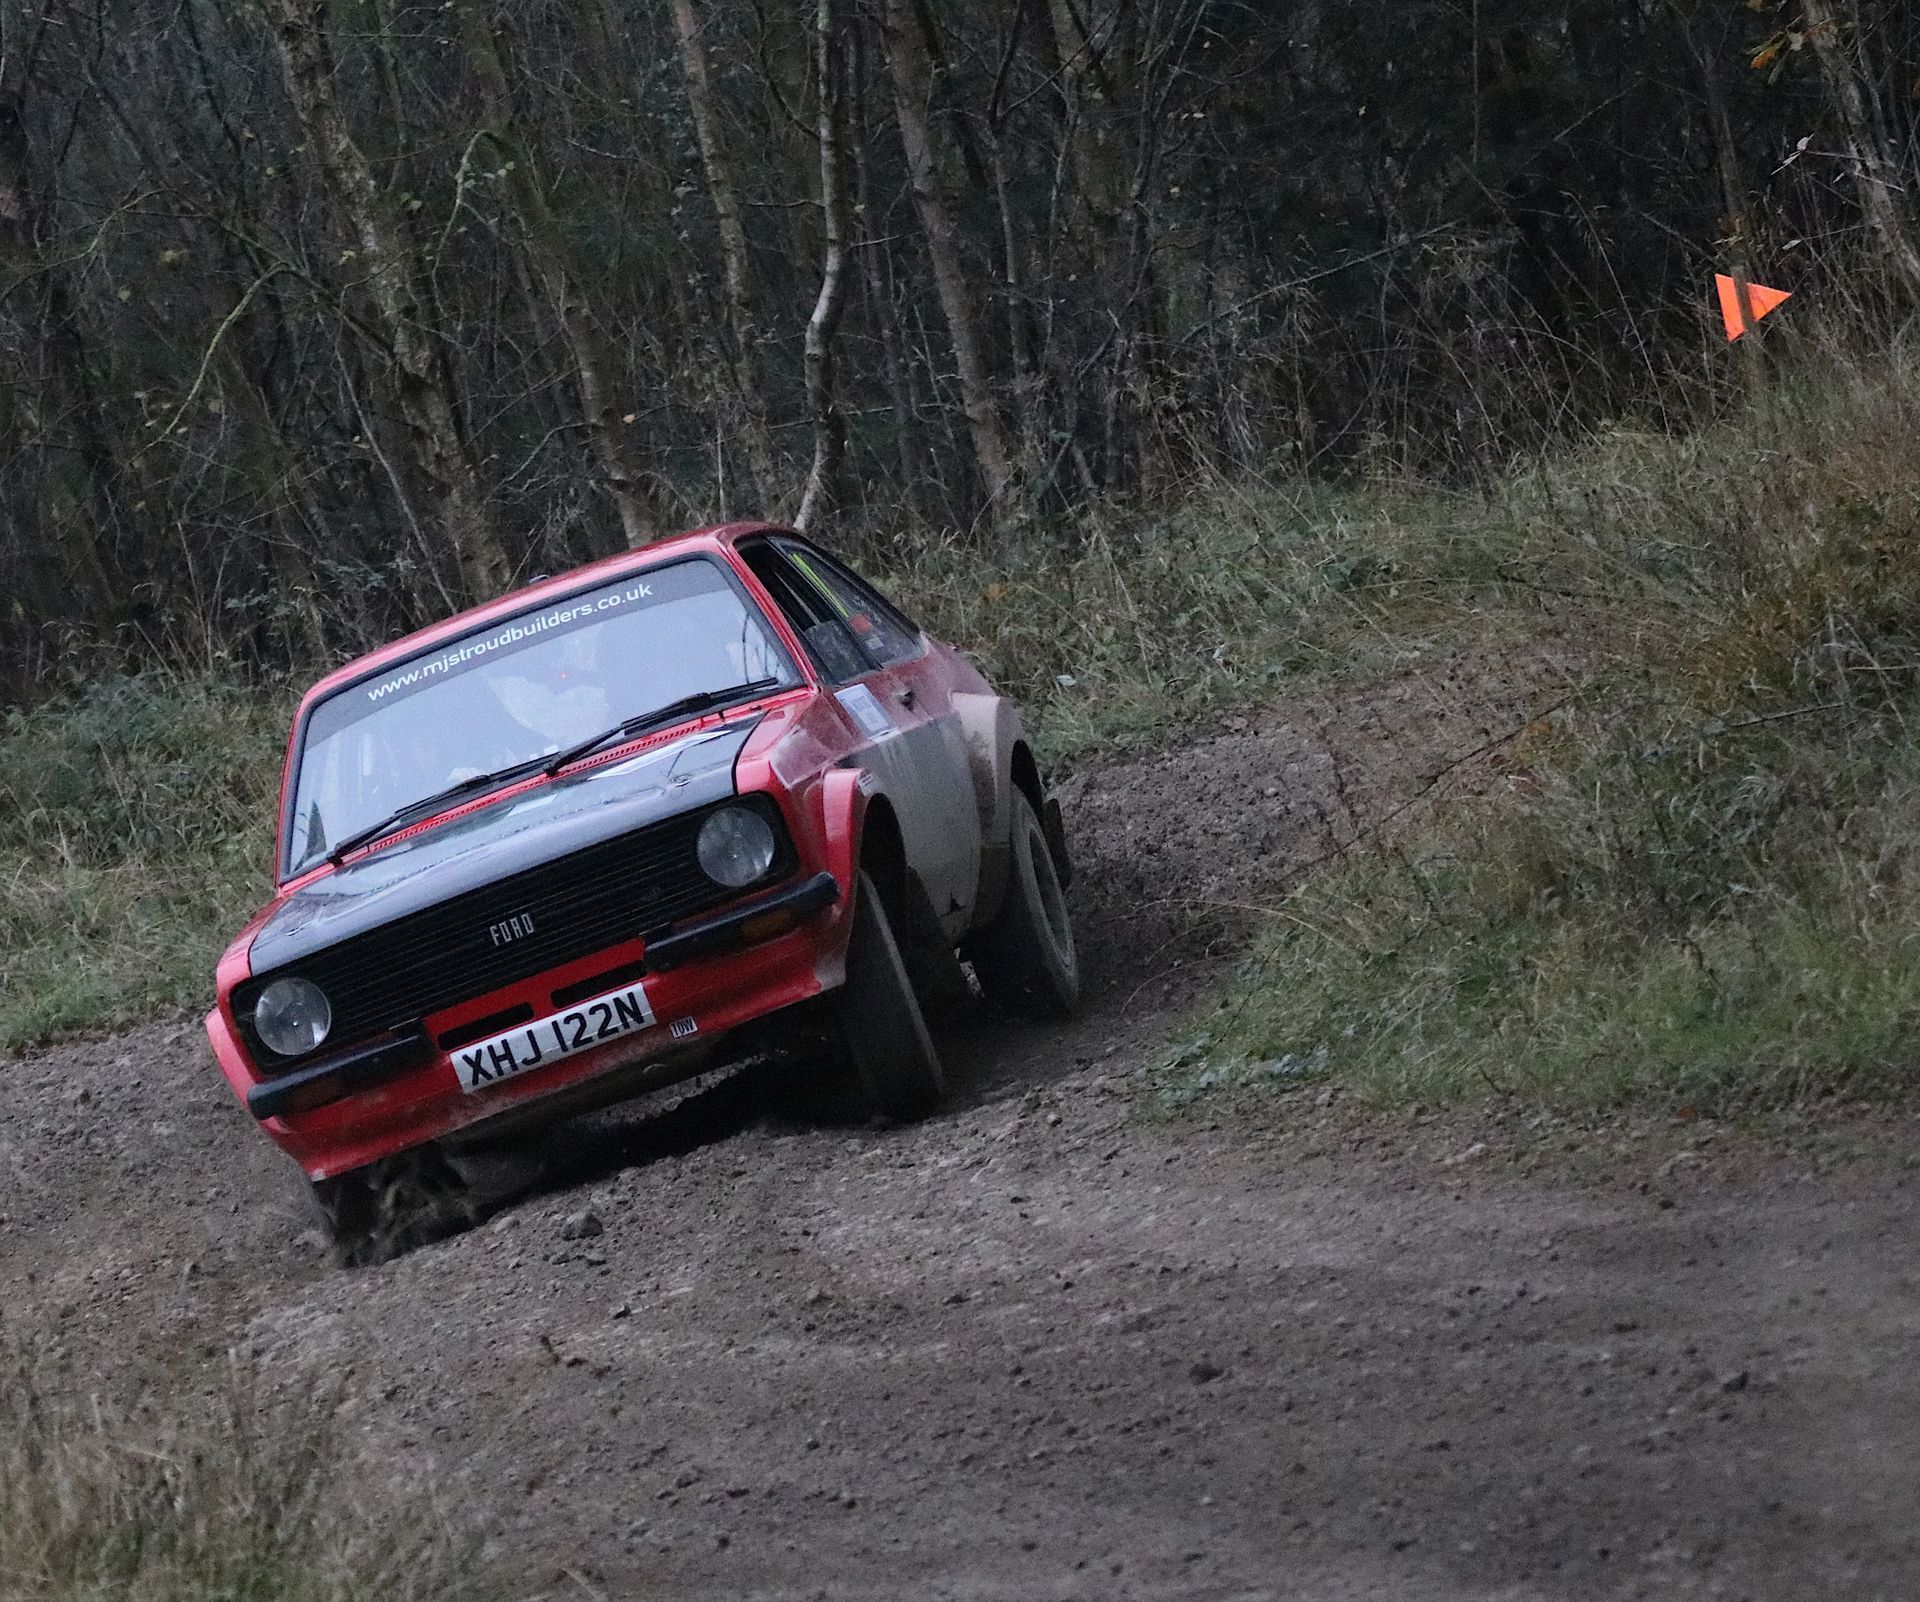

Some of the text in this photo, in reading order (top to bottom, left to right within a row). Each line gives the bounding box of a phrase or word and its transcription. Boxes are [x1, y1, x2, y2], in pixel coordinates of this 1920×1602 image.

[368, 583, 653, 701] www.mjstroudbuilders.co.uk
[490, 912, 534, 946] FORD
[462, 991, 645, 1086] XHJ 122N
[670, 1016, 694, 1037] TOW
